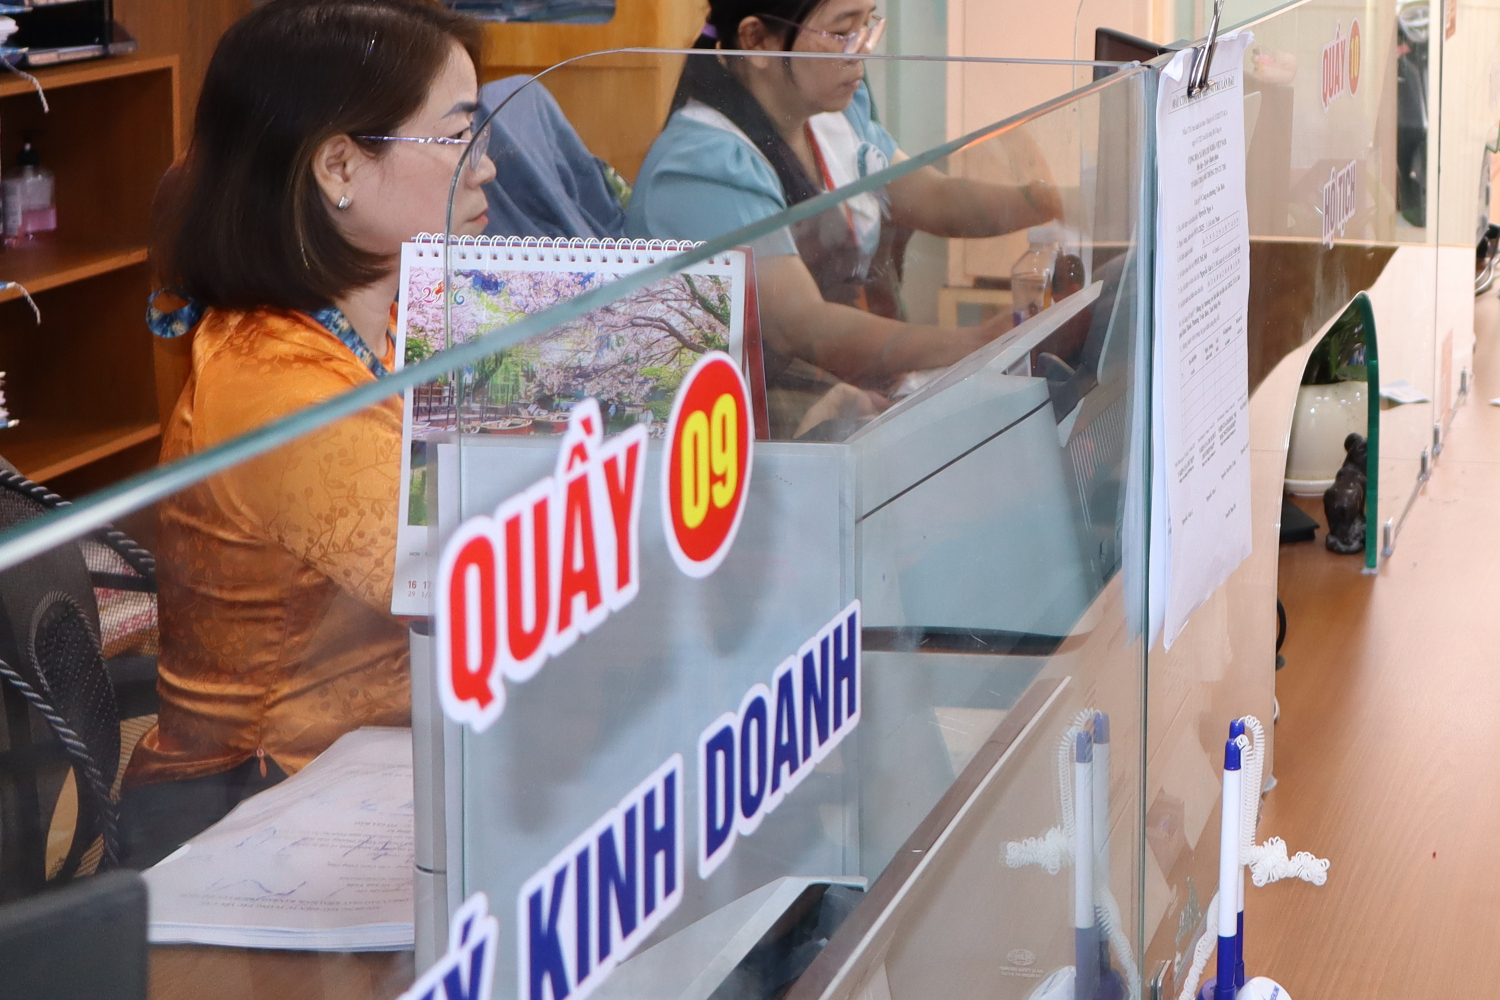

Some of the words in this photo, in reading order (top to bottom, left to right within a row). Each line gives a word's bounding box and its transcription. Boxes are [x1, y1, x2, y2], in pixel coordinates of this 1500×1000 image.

[1323, 22, 1346, 110] QUẦY
[1350, 34, 1359, 80] 10
[1324, 167, 1335, 248] HỘ
[1338, 162, 1356, 236] TỊCH
[408, 580, 417, 589] 16
[447, 415, 642, 711] QUẦY
[680, 393, 739, 529] 09
[529, 766, 678, 1000] KINH
[704, 609, 858, 862] DOANH
